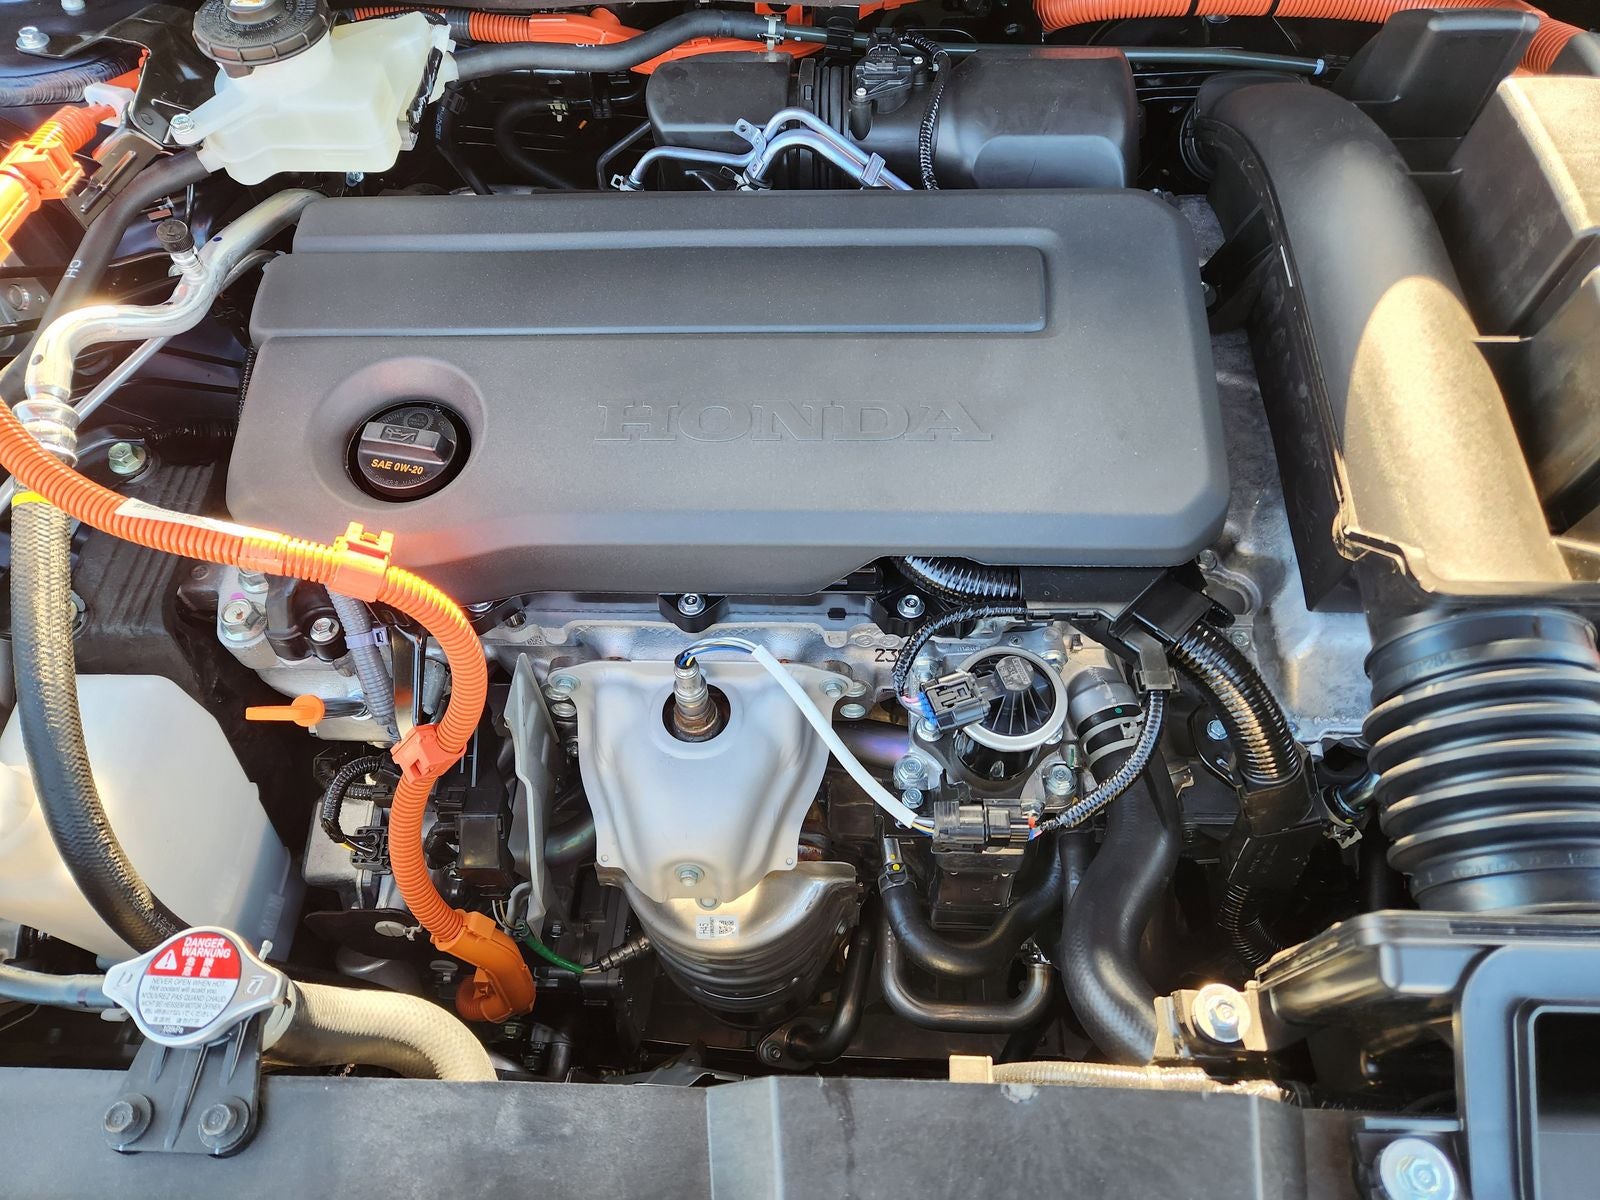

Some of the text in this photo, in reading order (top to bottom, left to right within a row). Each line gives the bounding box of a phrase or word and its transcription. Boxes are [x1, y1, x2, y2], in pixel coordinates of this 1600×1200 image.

[595, 400, 993, 442] HONDA
[371, 458, 393, 470] SAE
[393, 462, 424, 475] 0W-20
[184, 936, 226, 949] DANGER
[182, 946, 231, 959] WARNUNG
